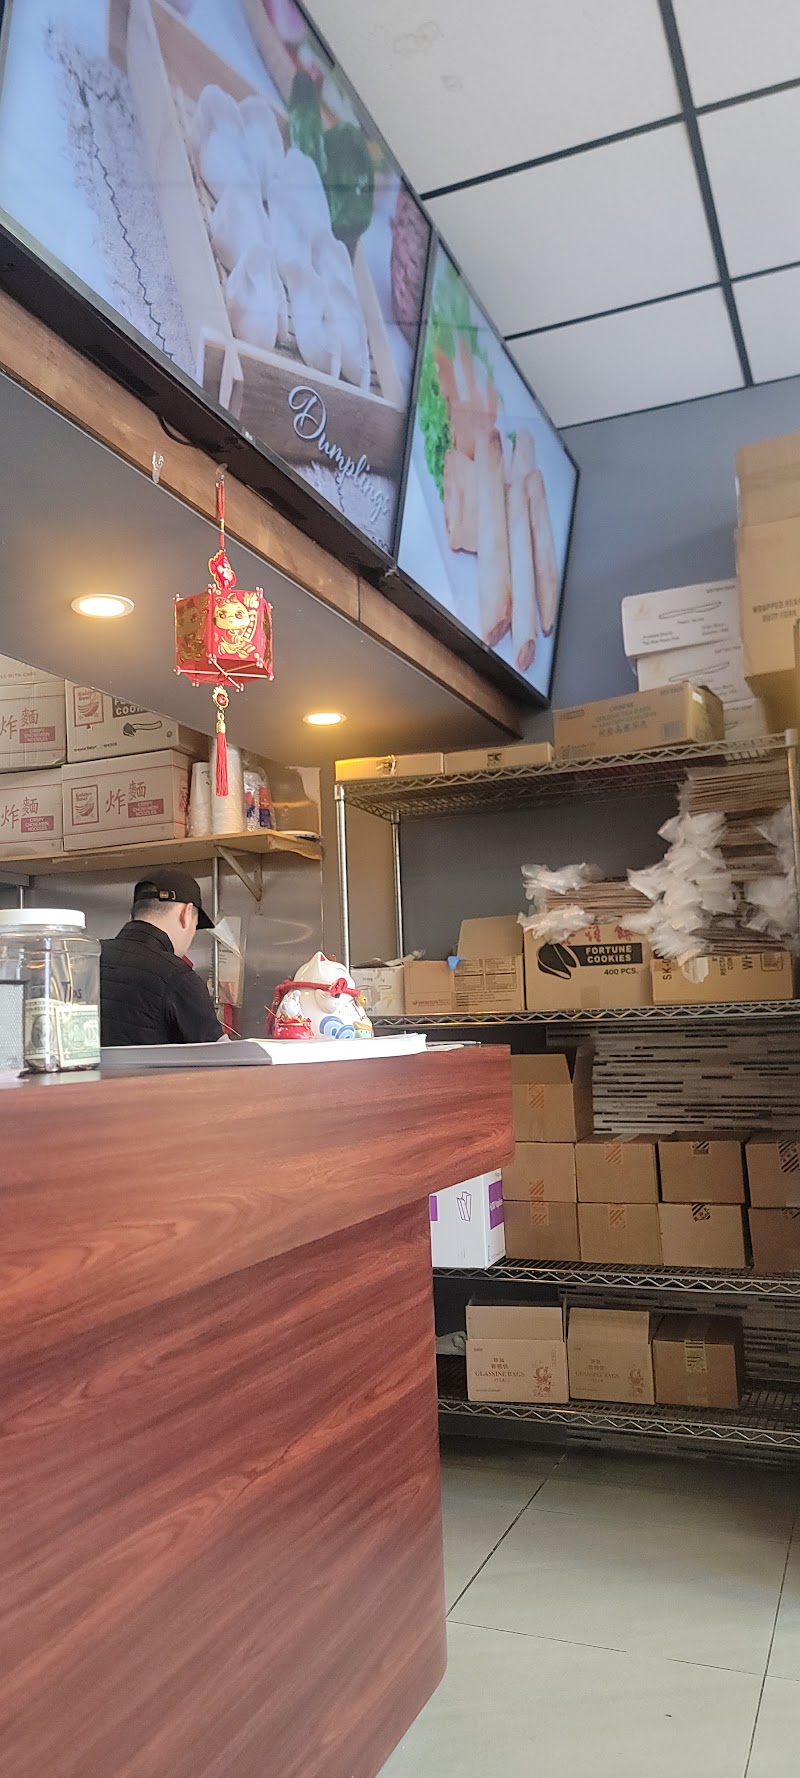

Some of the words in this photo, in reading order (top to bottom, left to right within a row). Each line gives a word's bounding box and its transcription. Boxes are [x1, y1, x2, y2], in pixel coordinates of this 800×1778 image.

[586, 945, 632, 955] FORTUNE
[587, 954, 632, 963] COOKIES
[620, 967, 638, 975] PCS.
